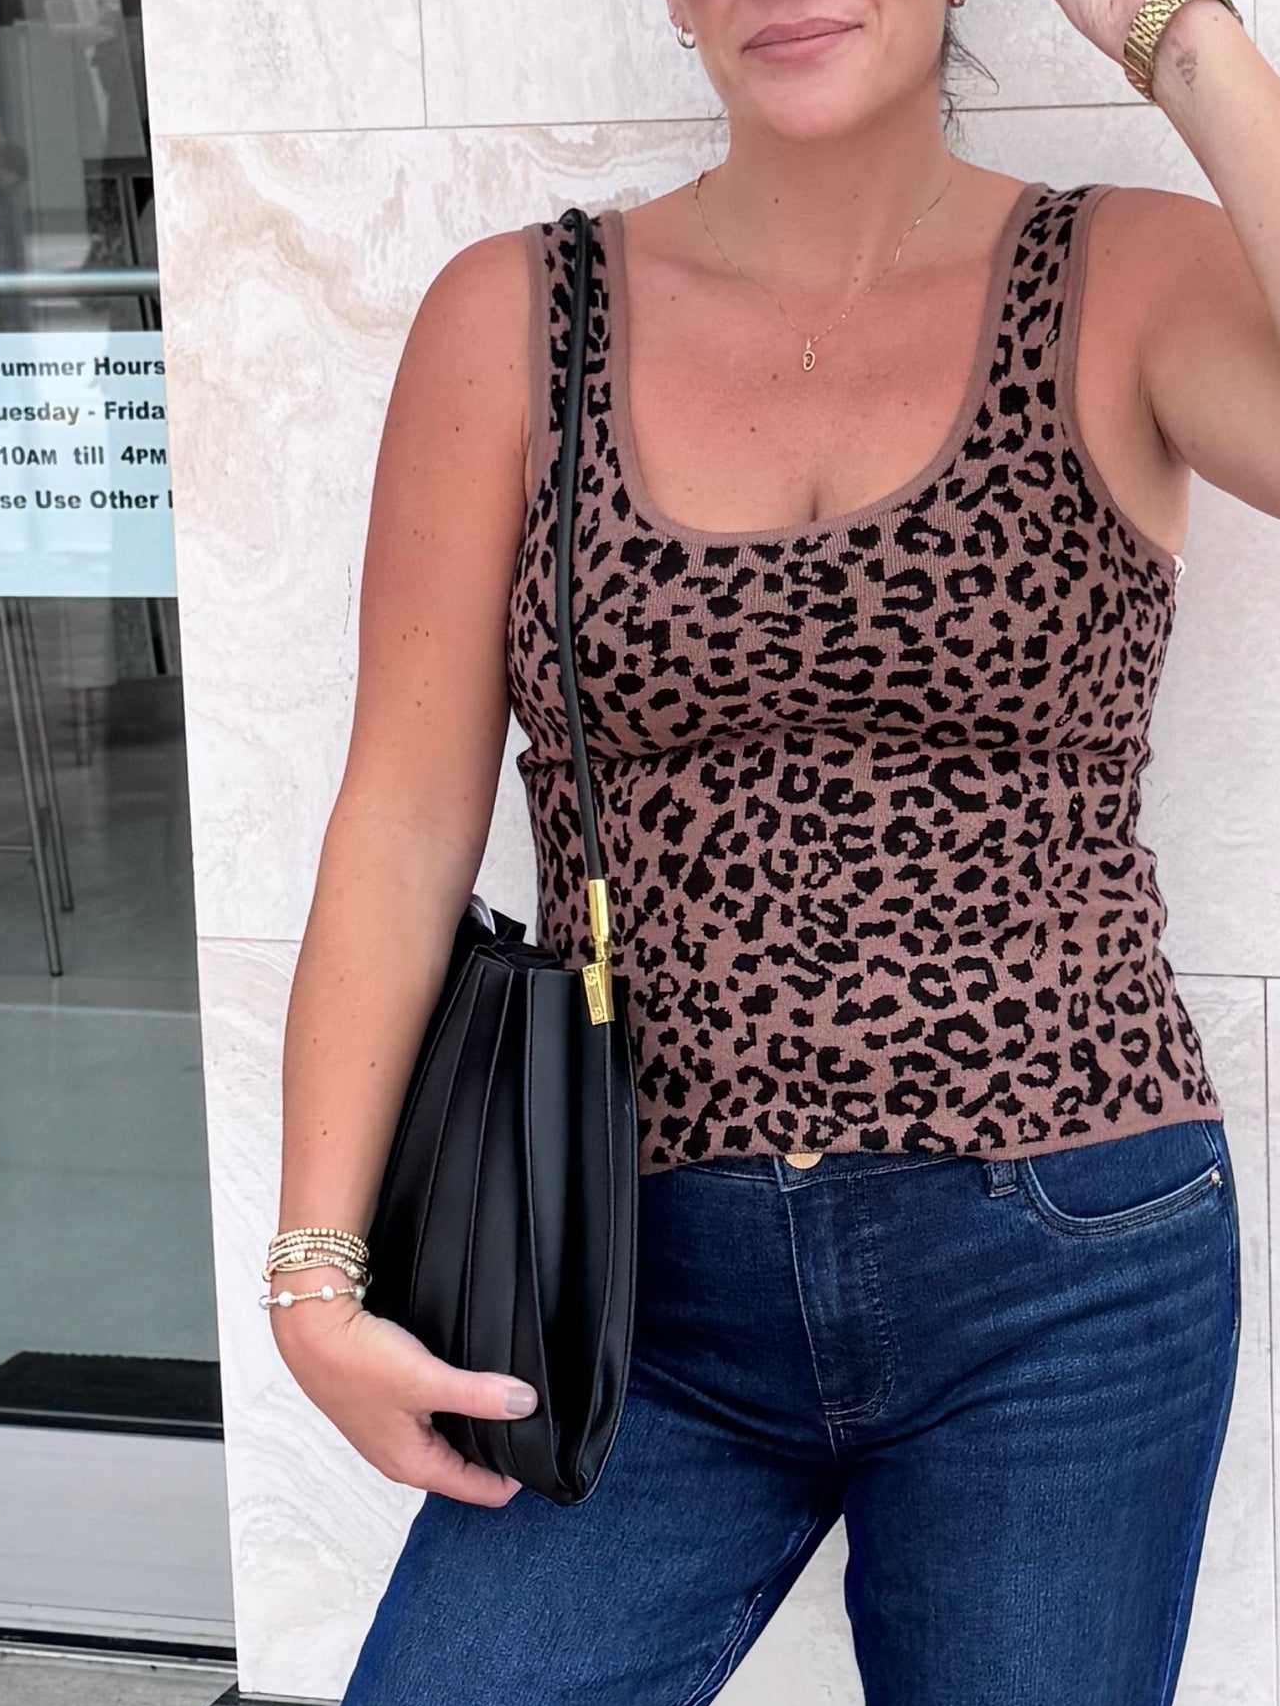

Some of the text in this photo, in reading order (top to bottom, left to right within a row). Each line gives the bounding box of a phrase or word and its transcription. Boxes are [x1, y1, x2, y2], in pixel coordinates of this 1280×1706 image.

[94, 356, 166, 376] Hours
[104, 400, 168, 424] Frida
[73, 445, 105, 465] till
[120, 445, 167, 465] 4PM
[35, 490, 82, 510] Use
[89, 490, 160, 510] Other
